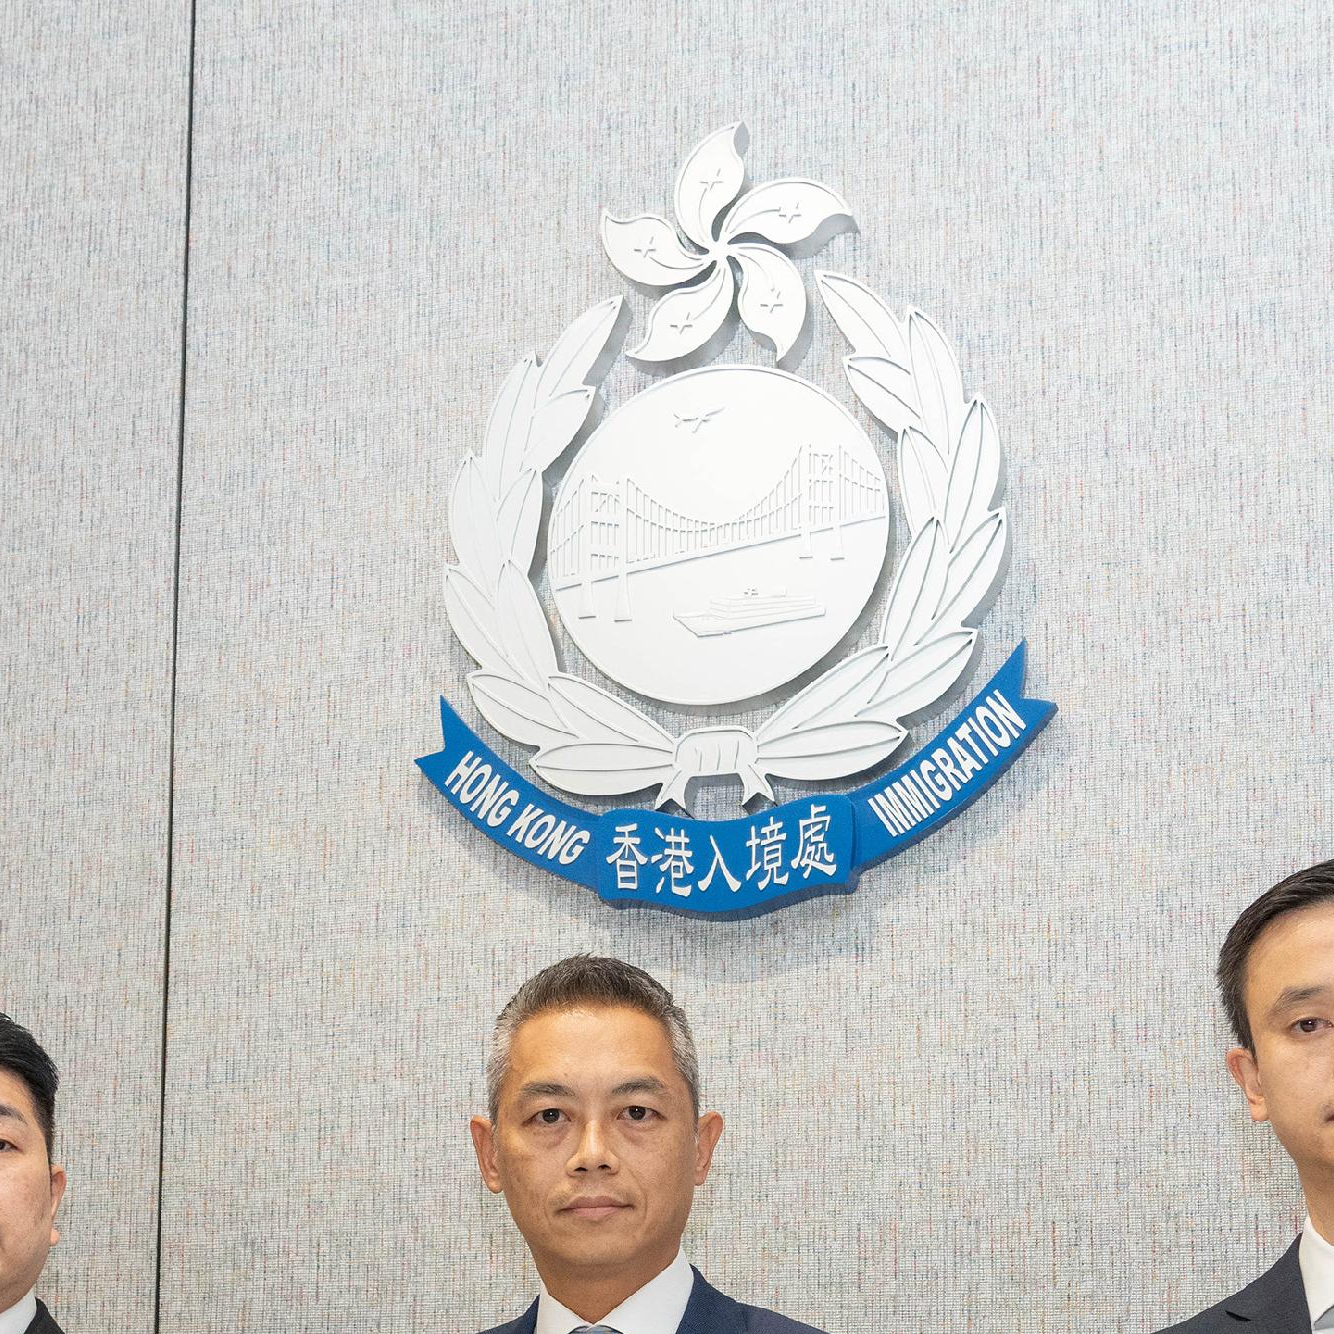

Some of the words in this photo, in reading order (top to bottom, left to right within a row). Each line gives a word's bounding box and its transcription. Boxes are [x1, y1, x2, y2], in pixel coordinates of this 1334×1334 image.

[444, 751, 520, 827] HONG
[507, 804, 591, 865] KONG
[868, 689, 1029, 837] IMMIGRATION
[606, 804, 836, 897] 香港入境處
